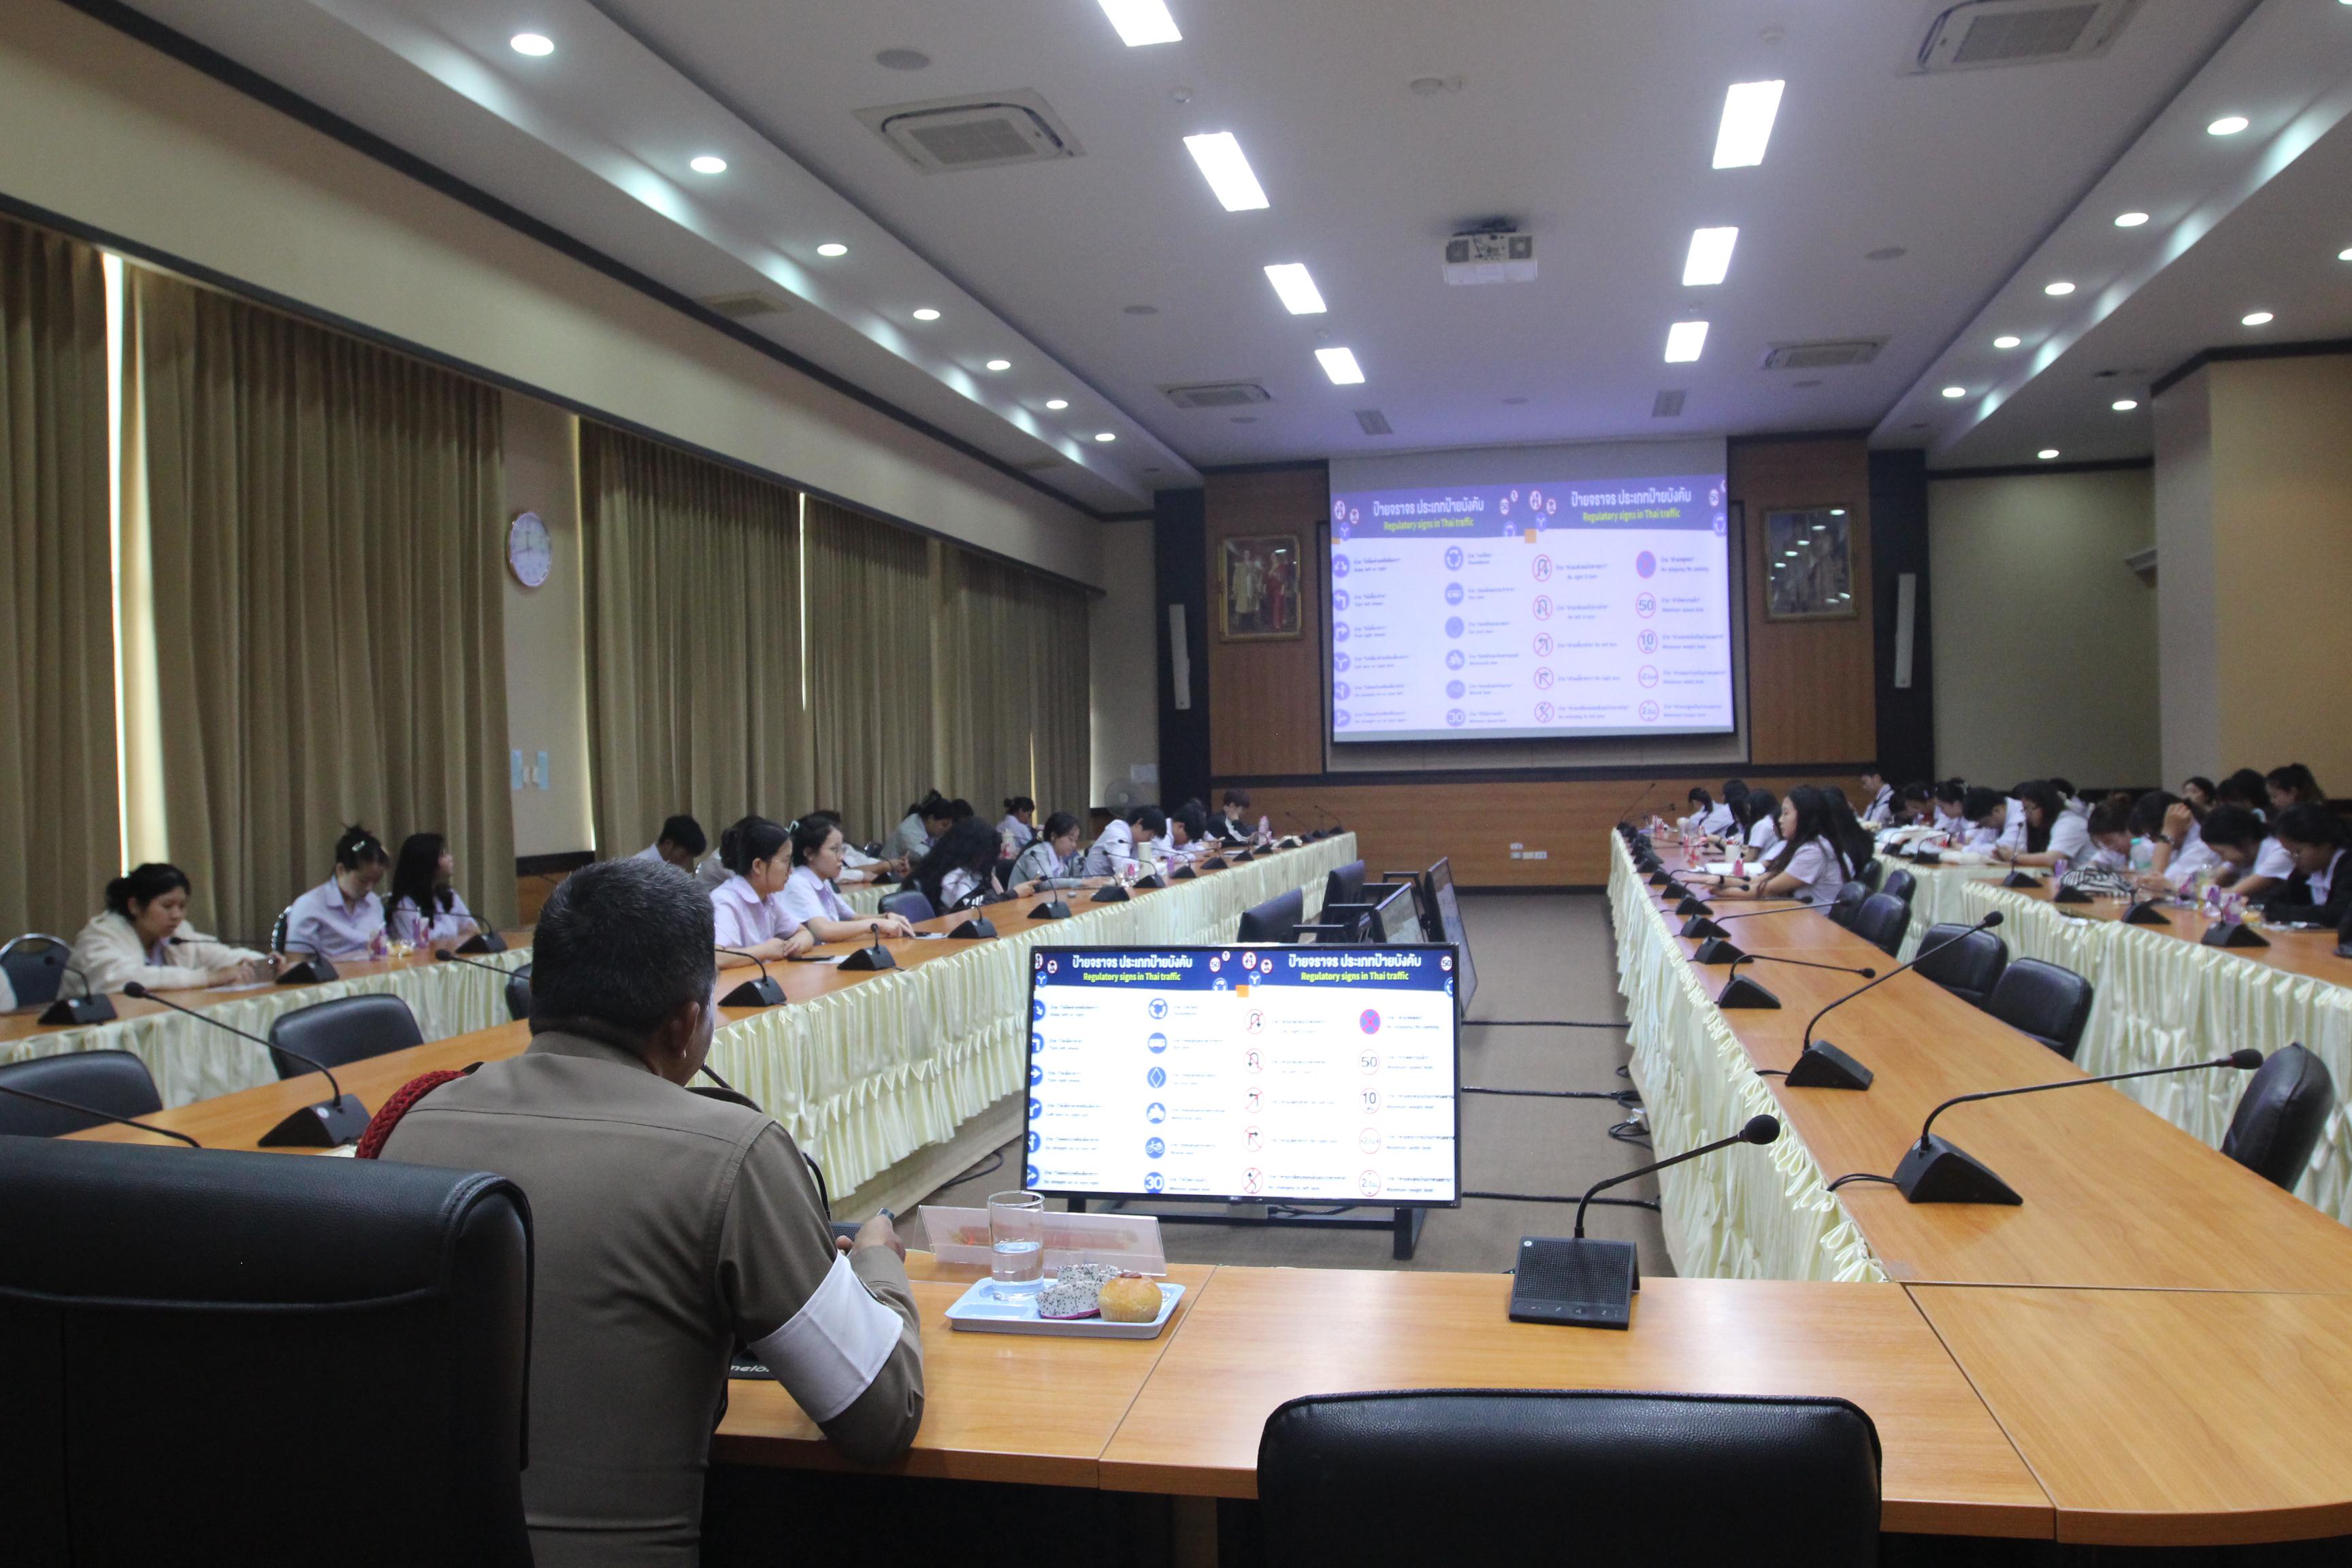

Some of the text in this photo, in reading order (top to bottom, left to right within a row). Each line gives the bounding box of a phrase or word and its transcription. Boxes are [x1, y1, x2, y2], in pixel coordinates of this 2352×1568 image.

[1571, 487, 1691, 507] ป้ายจราจร ประเภทป้ายบังคับ
[1373, 496, 1484, 517] ป้ายจราจร ประเภทป้ายบังคับ
[1582, 510, 1618, 523] Regulatory
[1619, 509, 1635, 523] signs
[1644, 509, 1659, 519] Thai
[1660, 508, 1680, 518] traffic
[1384, 520, 1416, 532] Regulatory
[1455, 517, 1474, 527] traffic
[1639, 599, 1654, 611] 50
[1641, 633, 1654, 645] 10
[1448, 713, 1463, 723] 30
[1073, 954, 1192, 968] ป้ายจราจร ประเภทป้ายบังคับ
[1289, 953, 1422, 967] ป้ายจราจร ประเภทป้ายบังคับ
[1083, 973, 1118, 983] Regulatory
[1120, 973, 1137, 983] signs
[1160, 972, 1181, 980] traffic
[1301, 971, 1409, 982] Regulatory signs in Thai traffic
[1361, 1056, 1377, 1068] 50
[1362, 1092, 1376, 1104] 10
[1145, 1175, 1162, 1190] 30
